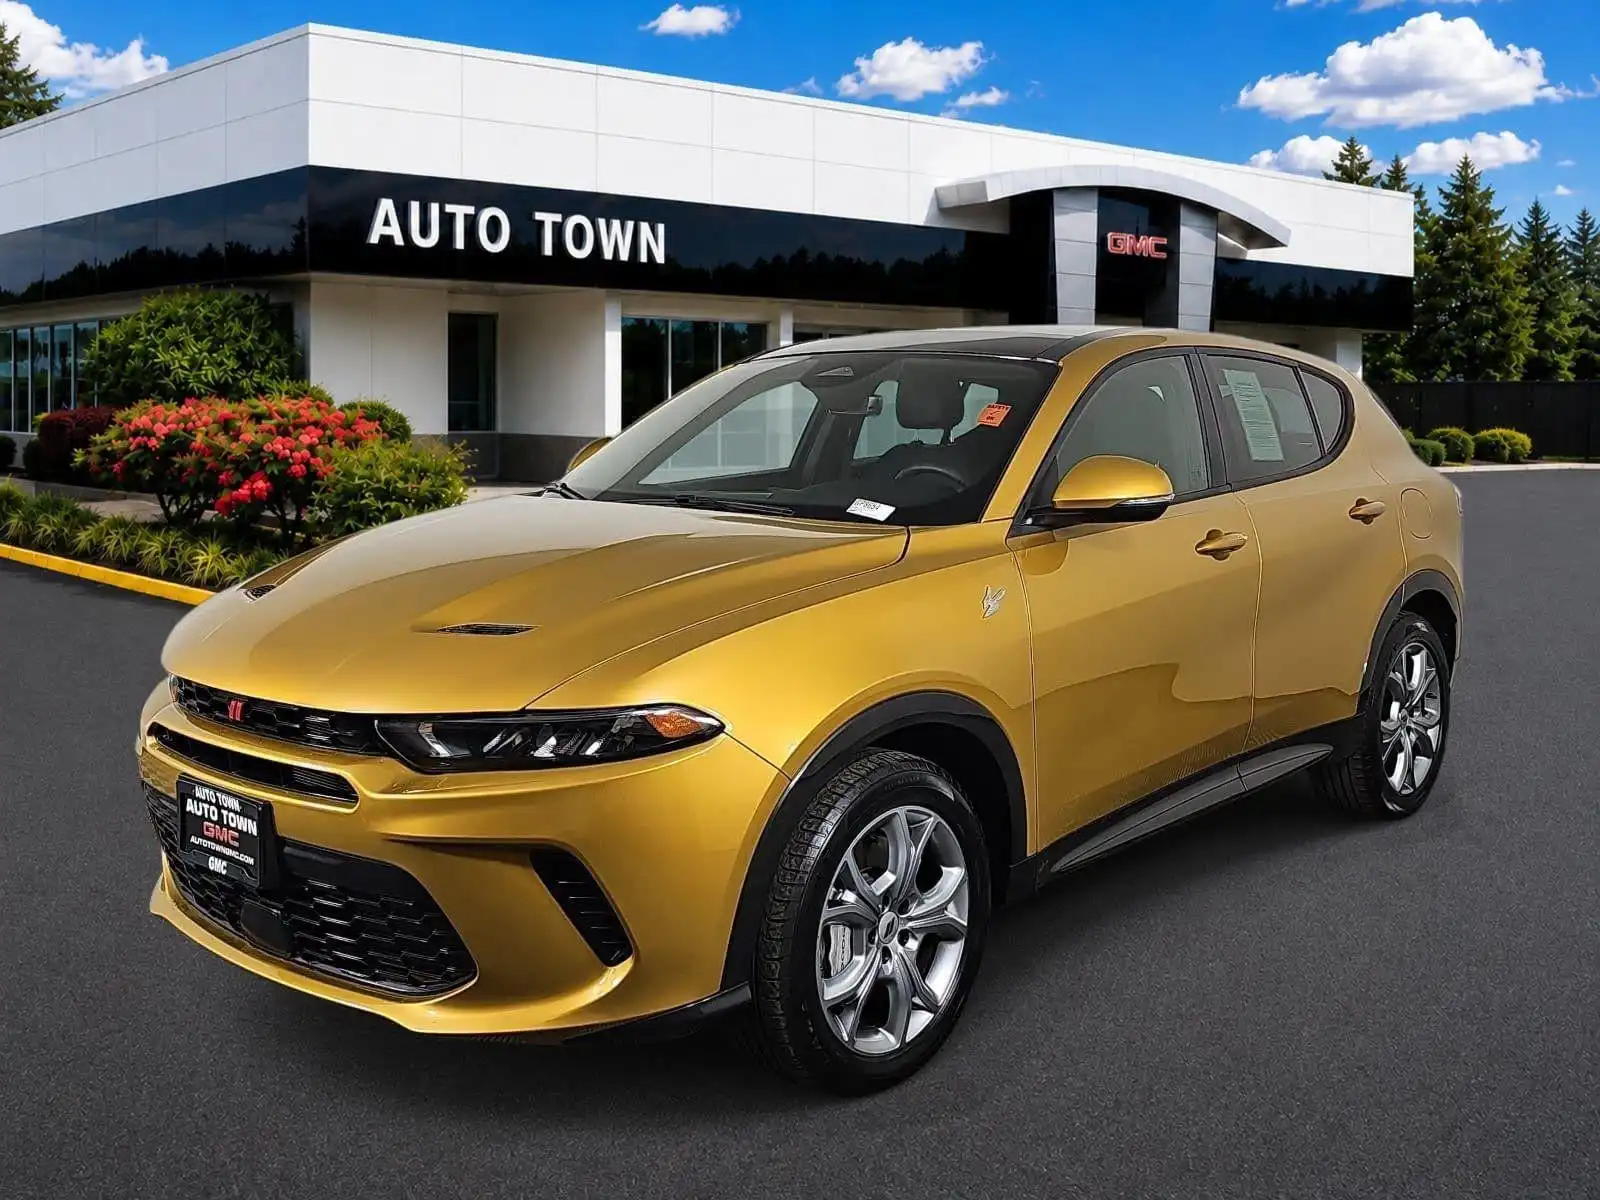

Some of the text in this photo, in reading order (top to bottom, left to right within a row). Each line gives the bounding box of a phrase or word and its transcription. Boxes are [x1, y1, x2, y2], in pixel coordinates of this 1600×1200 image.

[367, 198, 666, 265] AUTO TOWN
[1107, 231, 1167, 259] GMC
[195, 785, 241, 812] AUTO TOWN
[186, 798, 258, 837] AUTO TOWN
[203, 821, 240, 848] GMC
[208, 855, 228, 875] GMC
